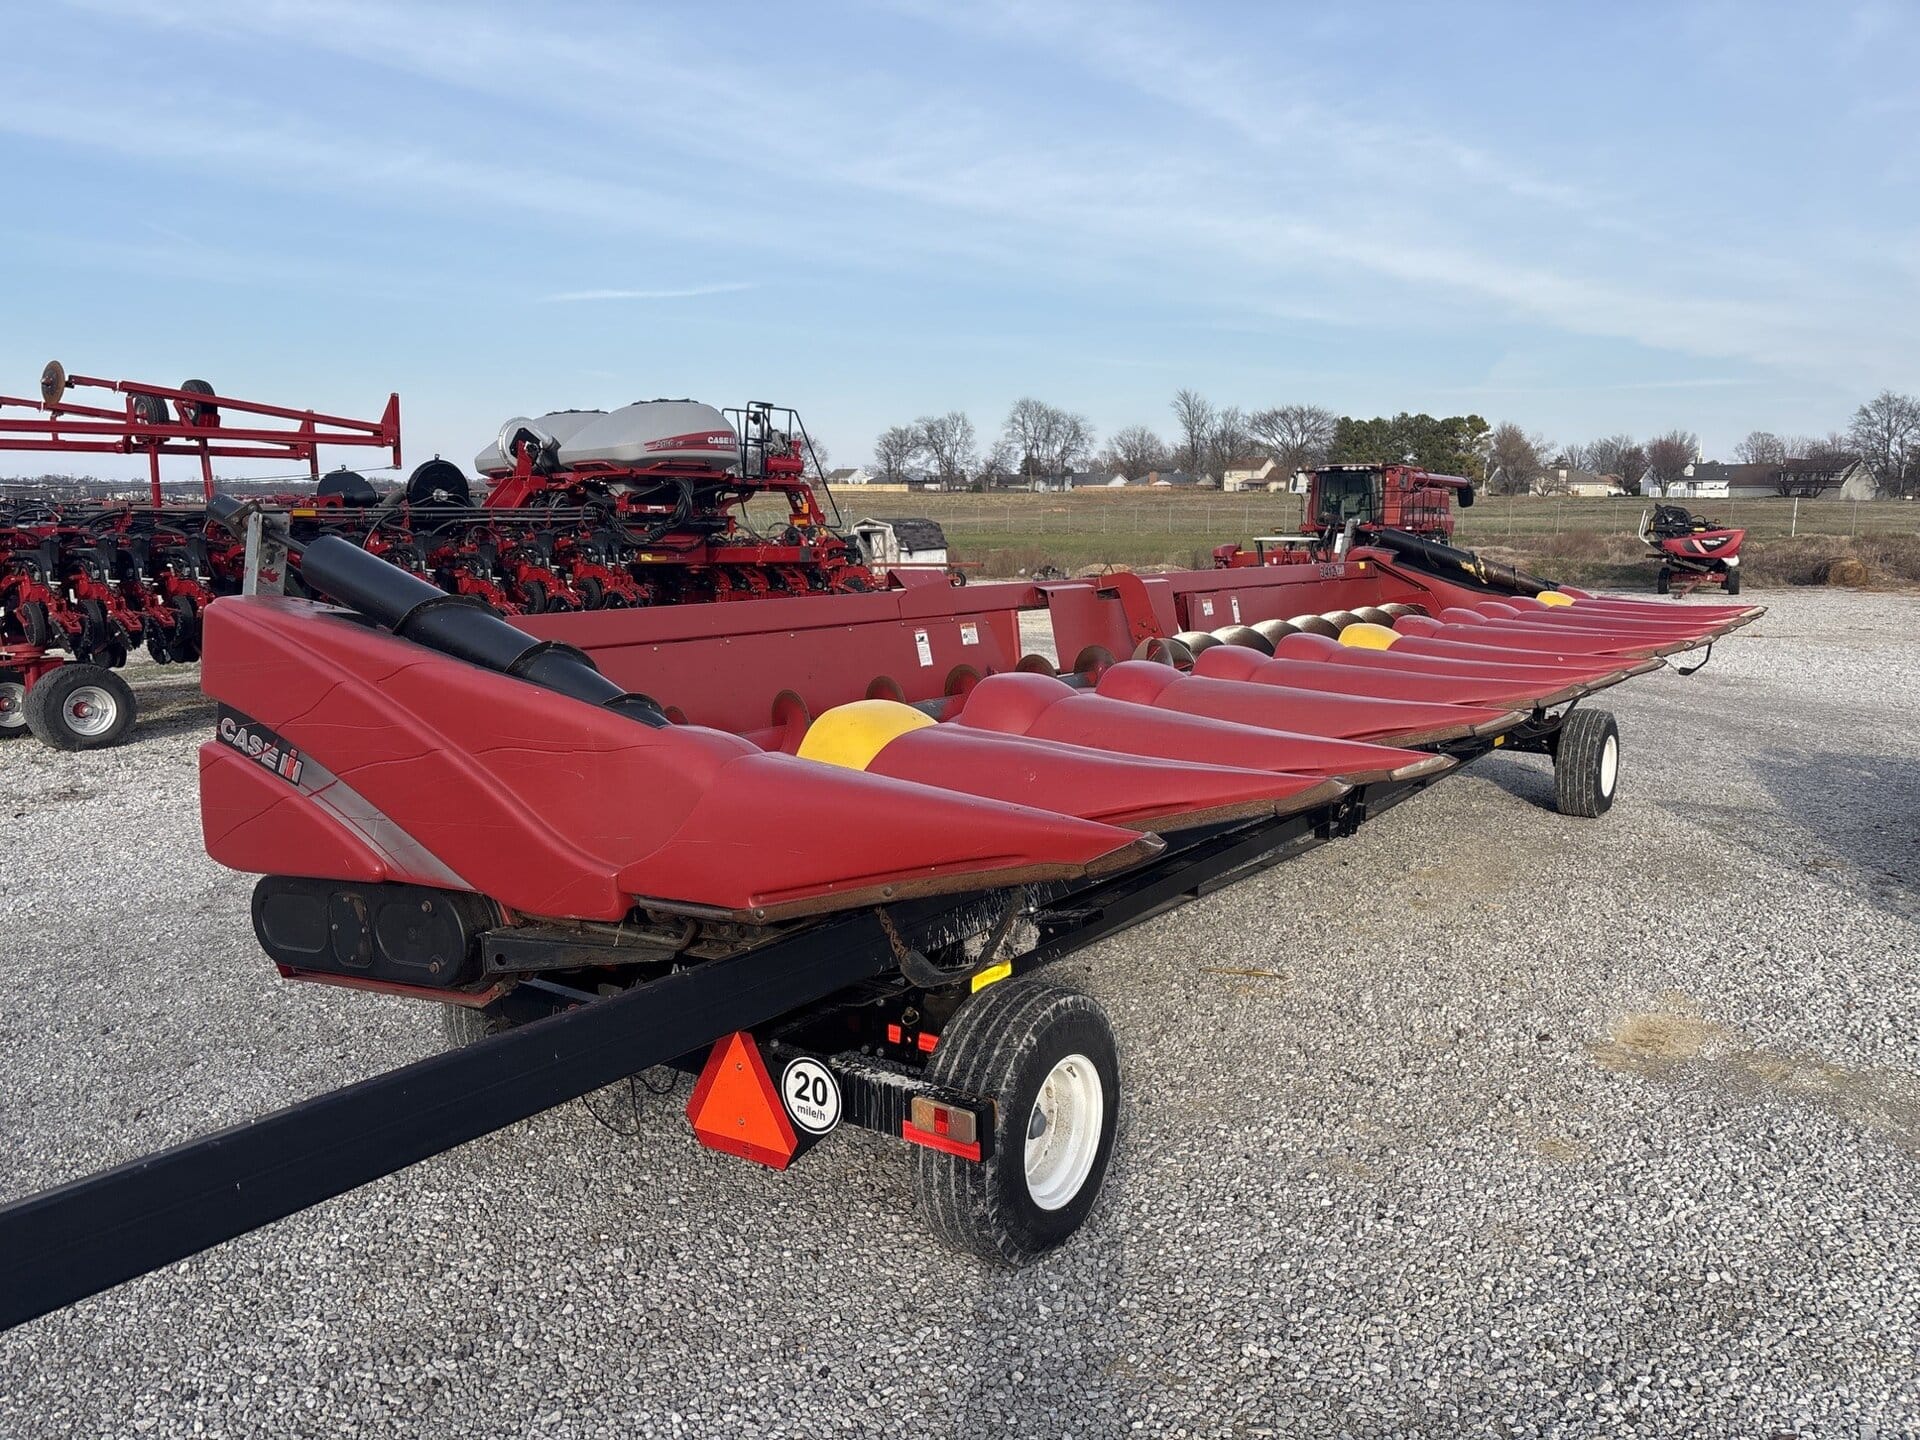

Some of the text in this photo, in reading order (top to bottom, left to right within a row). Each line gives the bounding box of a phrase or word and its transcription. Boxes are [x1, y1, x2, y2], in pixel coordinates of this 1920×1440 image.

[708, 436, 728, 444] CASE
[220, 717, 279, 770] CASE
[794, 1070, 828, 1107] 20
[797, 1105, 826, 1121] mile/h
